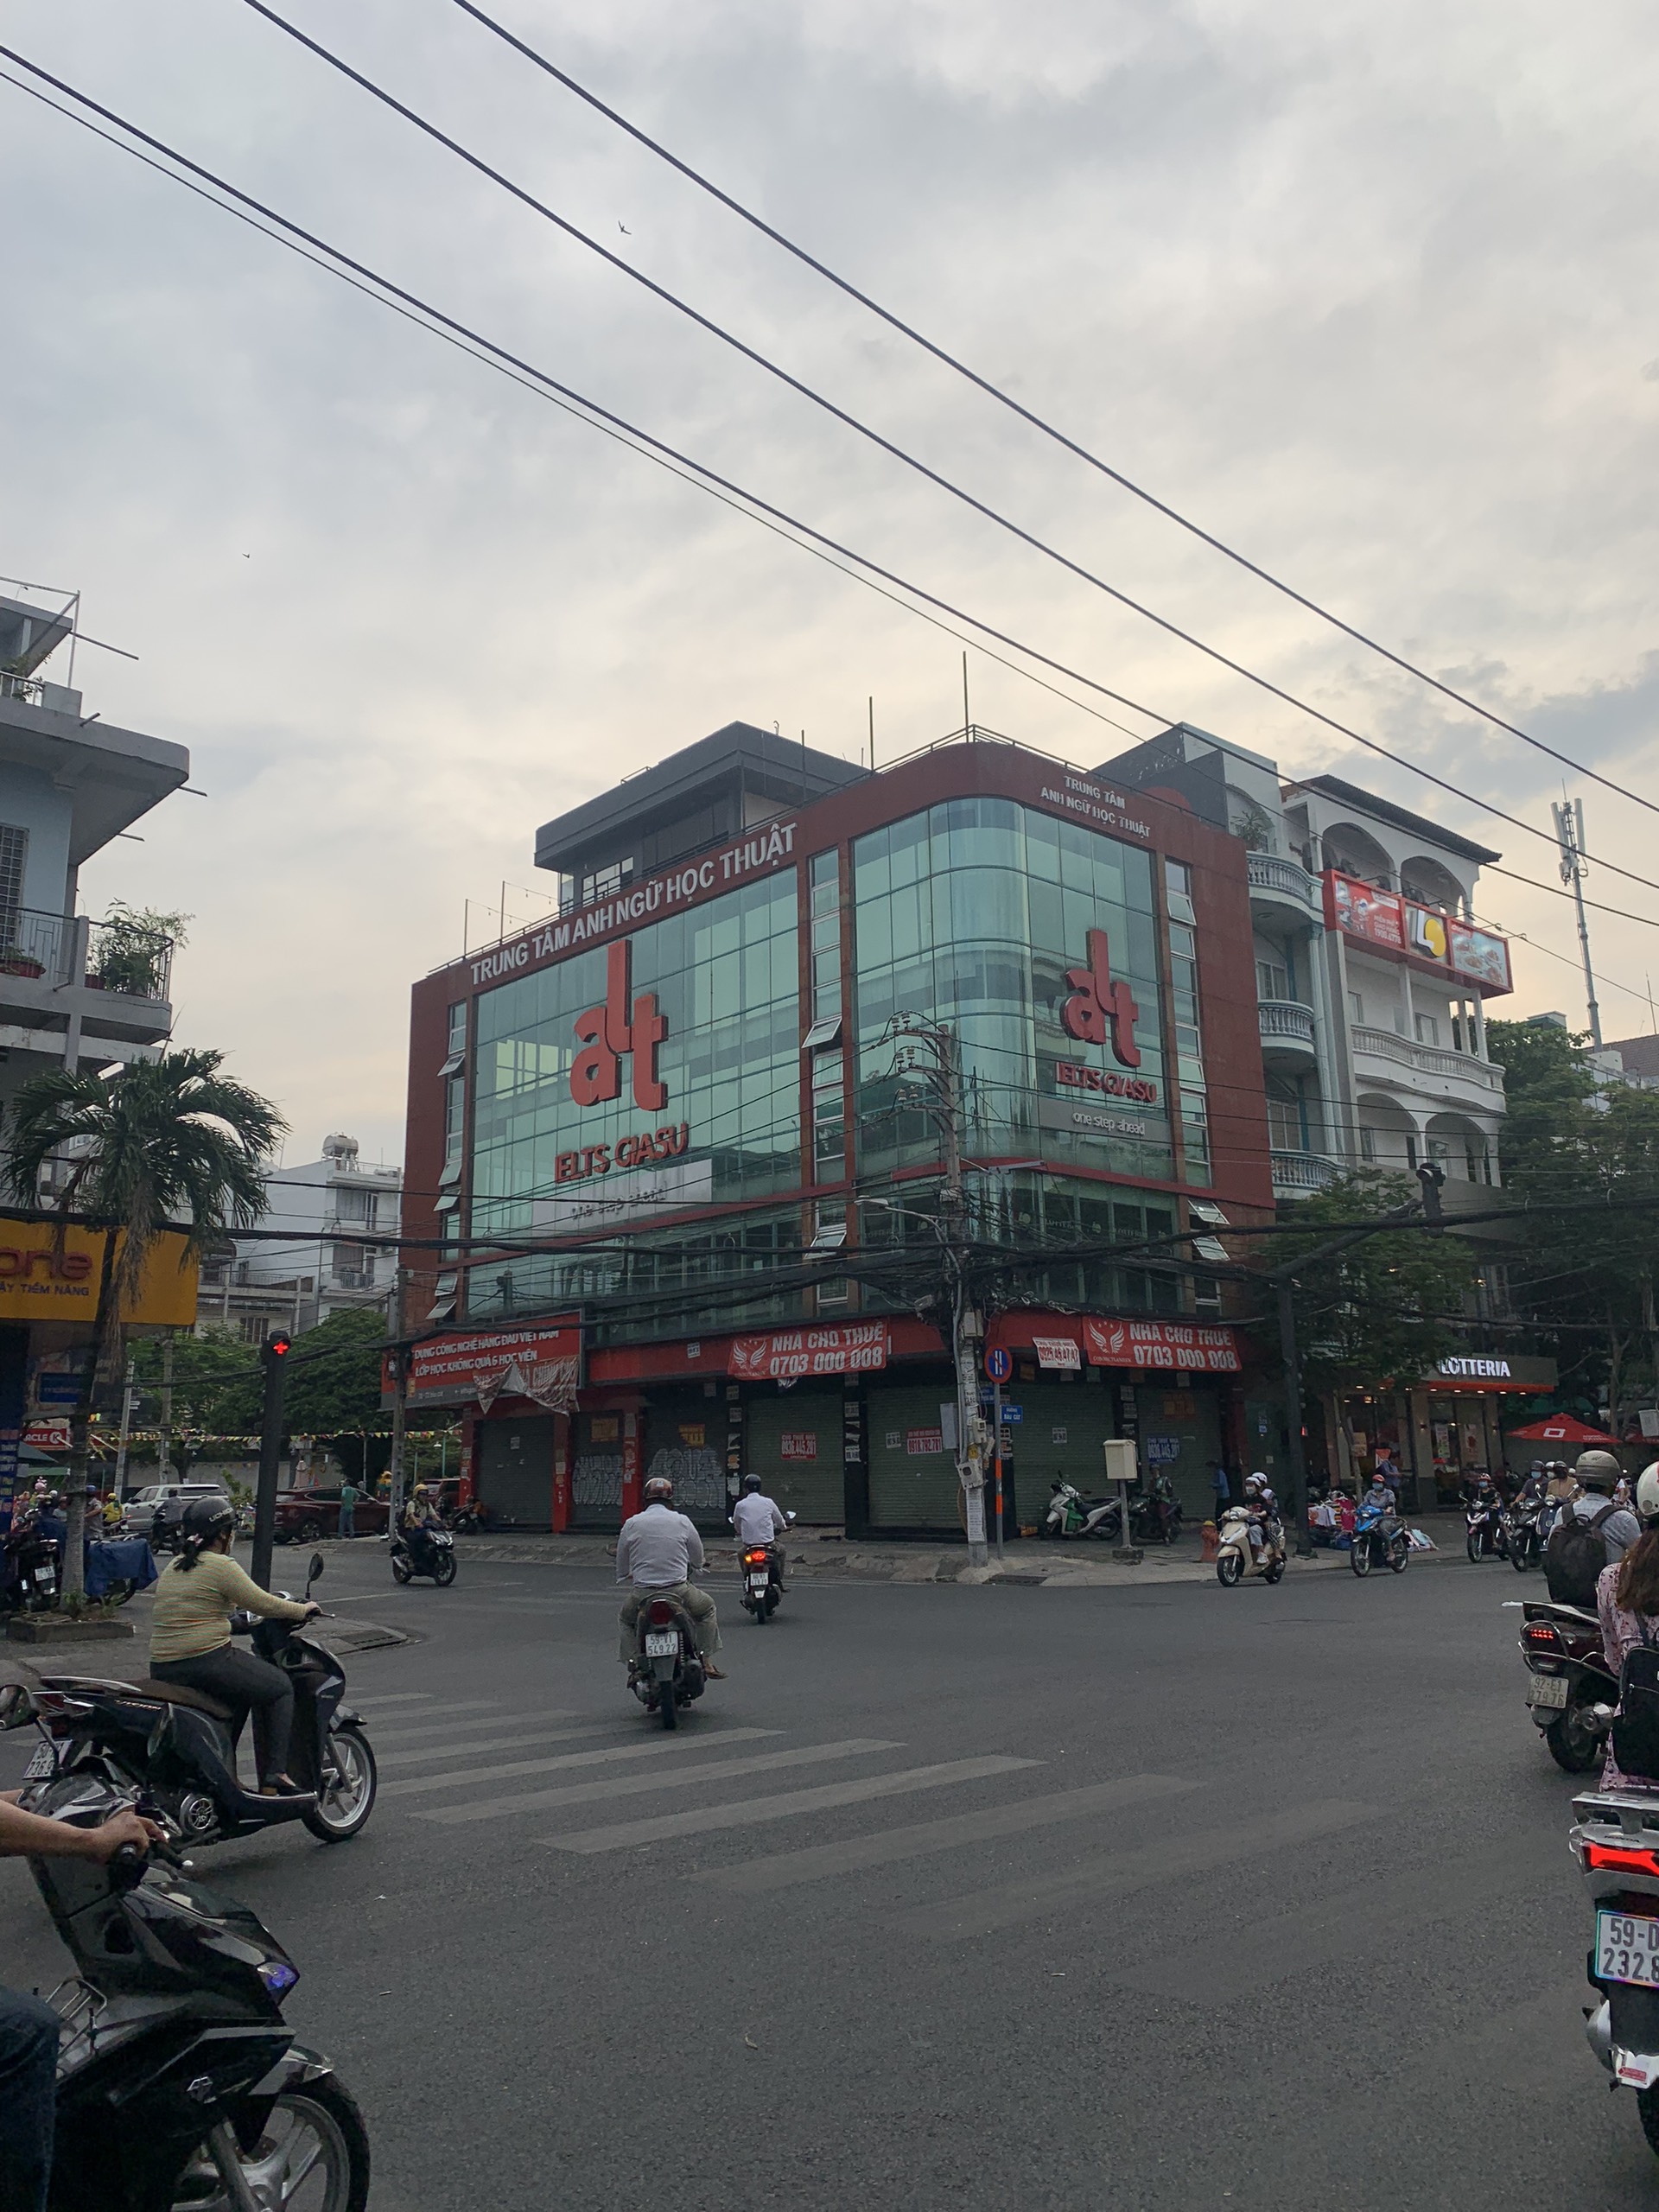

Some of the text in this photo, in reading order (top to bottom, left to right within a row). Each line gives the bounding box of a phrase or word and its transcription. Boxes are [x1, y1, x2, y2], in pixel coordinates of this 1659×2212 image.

[1064, 775, 1125, 810] TRUNG TÂM
[1040, 786, 1150, 839] ANH NGỮ HỌC THUẬT
[470, 822, 798, 986] TRUNG TÂM ANH NGỮ HỌC THUẬT
[1072, 1112, 1145, 1135] one step ahead
[772, 1322, 884, 1353] NHÀ CHO THUÊ
[1164, 1325, 1193, 1344] CHO
[1197, 1327, 1232, 1347] THUÊ
[492, 1355, 499, 1366] 6
[769, 1345, 883, 1376] 0703 000 008
[1133, 1344, 1238, 1370] 0703 000 008
[1439, 1357, 1510, 1377] LOTTERIA
